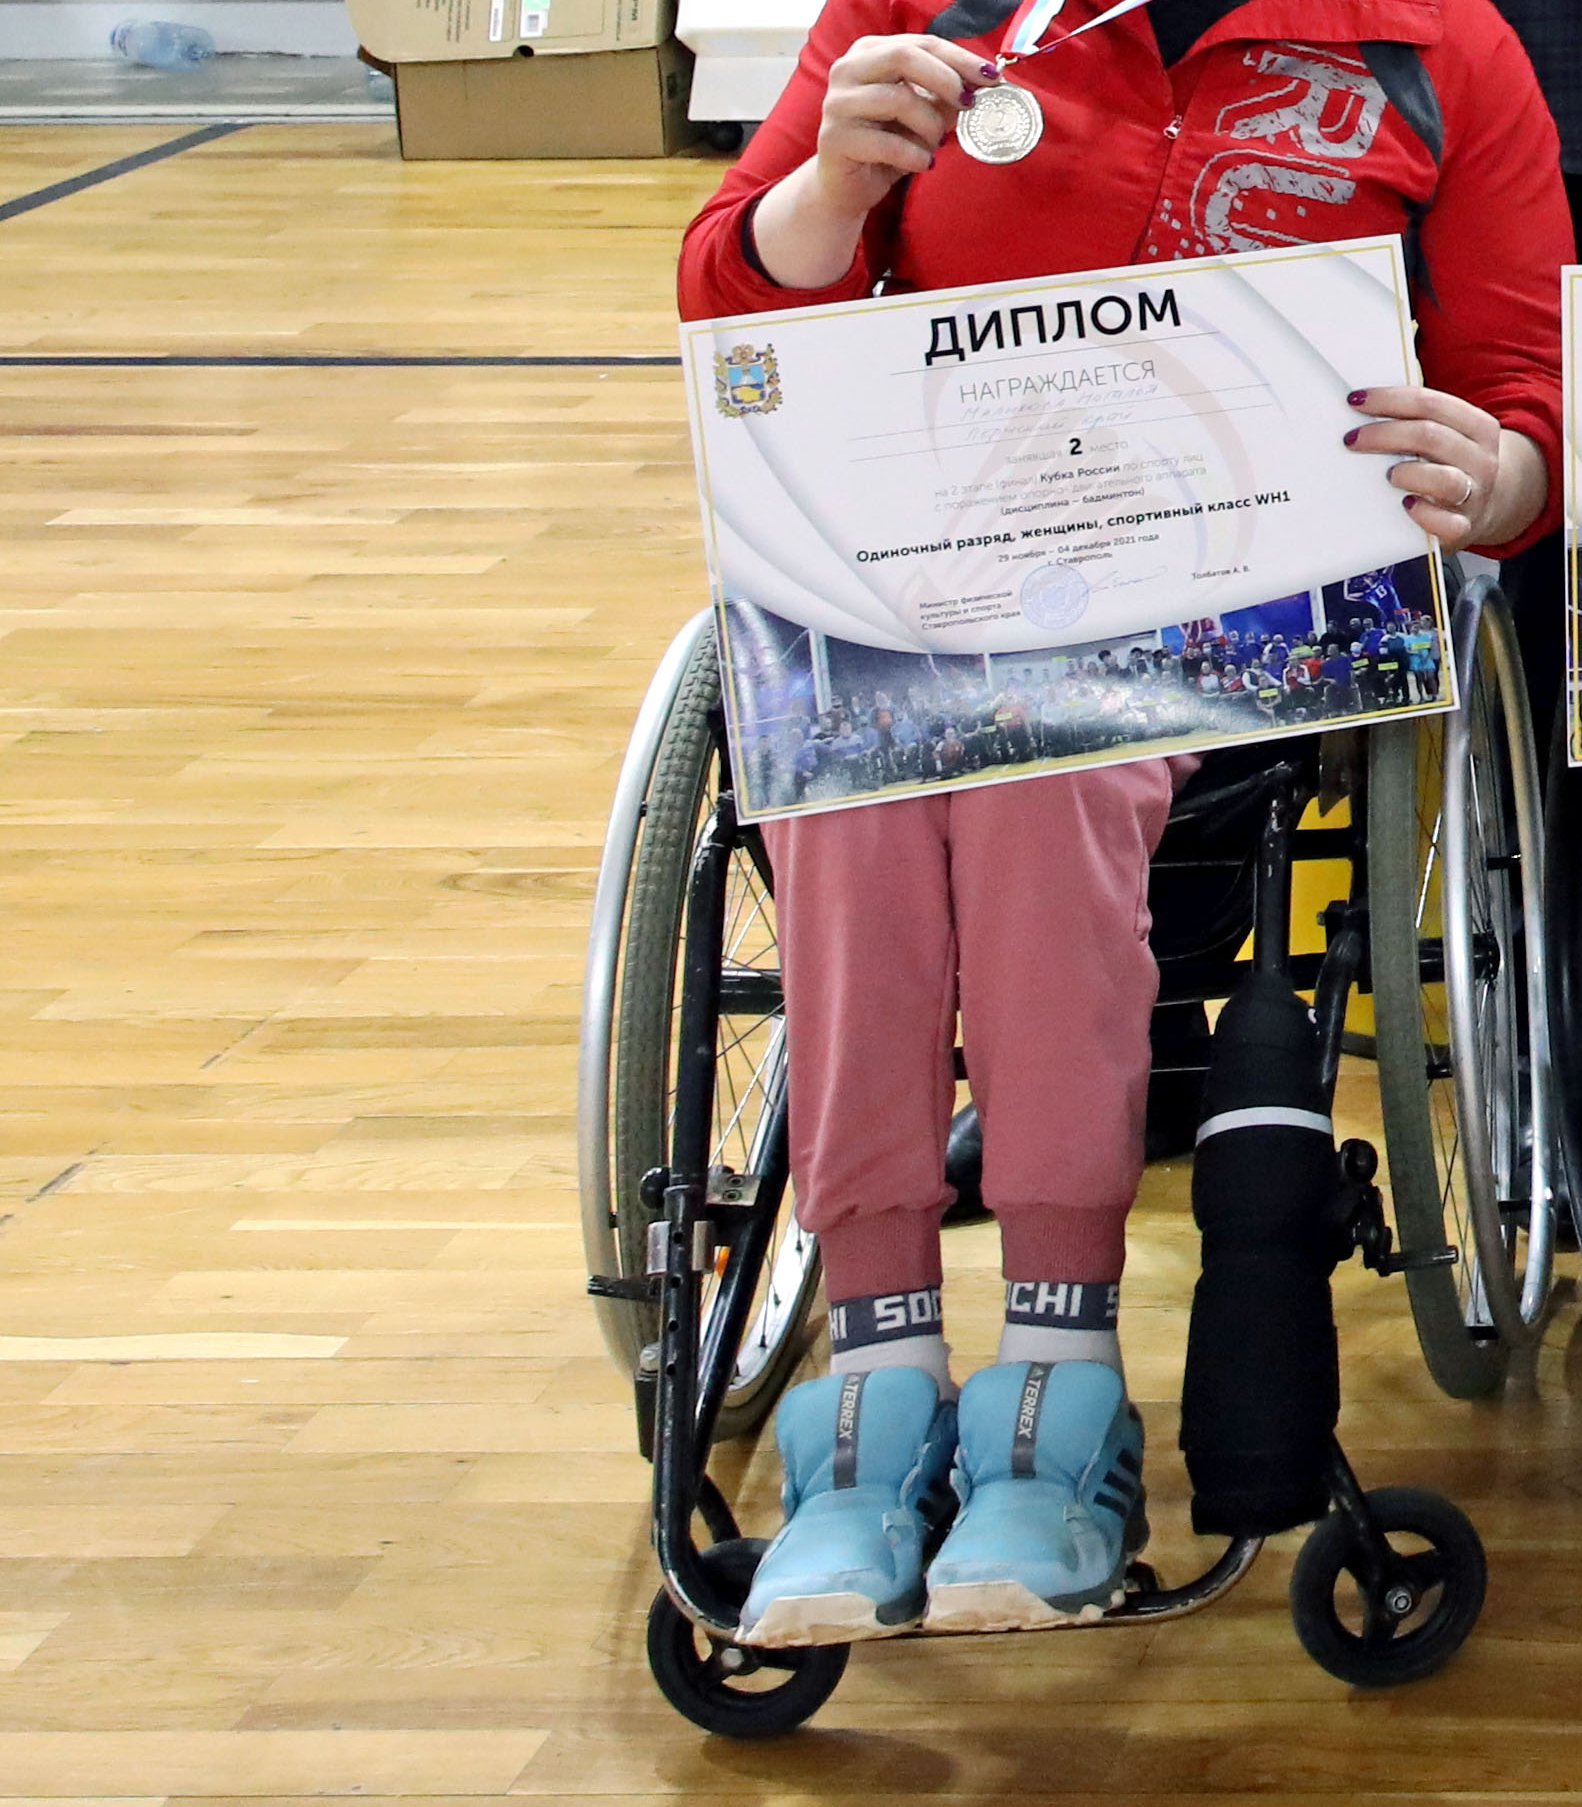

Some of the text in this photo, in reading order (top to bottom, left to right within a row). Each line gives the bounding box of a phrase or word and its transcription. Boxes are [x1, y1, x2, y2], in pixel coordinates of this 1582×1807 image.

[925, 289, 1181, 366] ДИПЛОМ
[960, 359, 1156, 403] НАГРАЖДАЕТСЯ
[1069, 438, 1083, 455] 2
[1089, 439, 1129, 453] место
[1040, 468, 1075, 484] Кубка
[1077, 463, 1120, 477] России
[1001, 498, 1070, 516] (дисциплина
[1083, 487, 1145, 505] бадминтон)
[856, 490, 1291, 564] Одиночный разряд, женщины, спортивный класс WH1
[998, 554, 1010, 563] 29
[1058, 546, 1070, 555] 04
[1113, 536, 1136, 547] 2021
[838, 1383, 859, 1440] TERREX
[1017, 1378, 1042, 1440] TERREX
